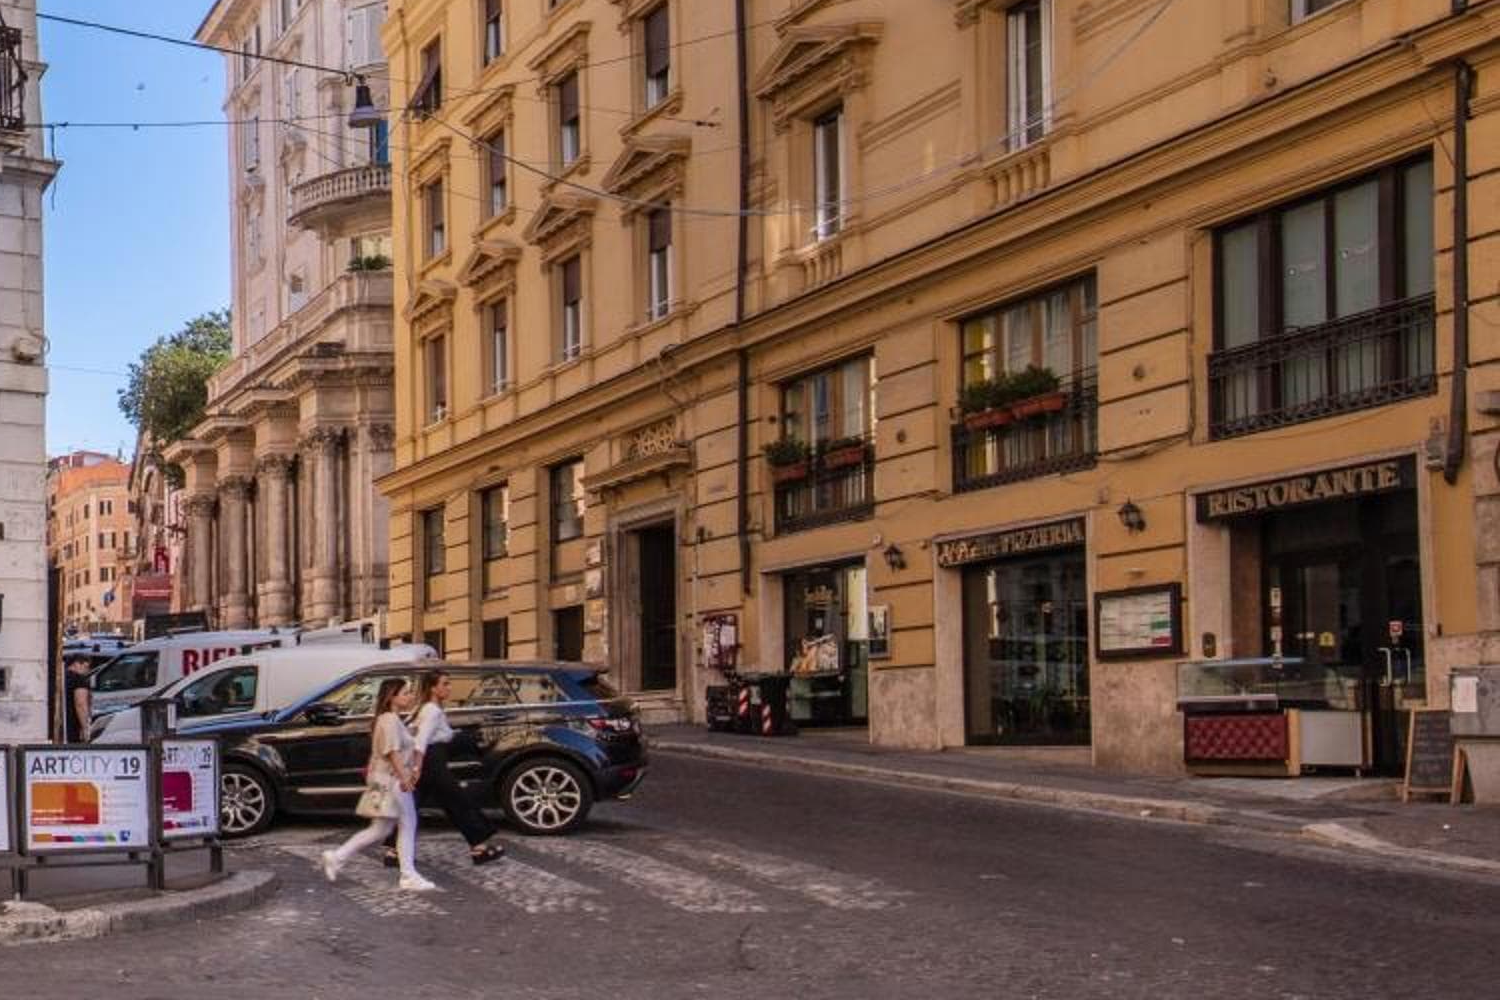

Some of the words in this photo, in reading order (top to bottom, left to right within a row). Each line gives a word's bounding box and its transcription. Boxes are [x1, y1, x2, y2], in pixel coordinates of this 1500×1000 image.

[1208, 463, 1400, 517] RISTORANTE
[30, 755, 111, 774] ARTCITY
[120, 756, 141, 774] 19
